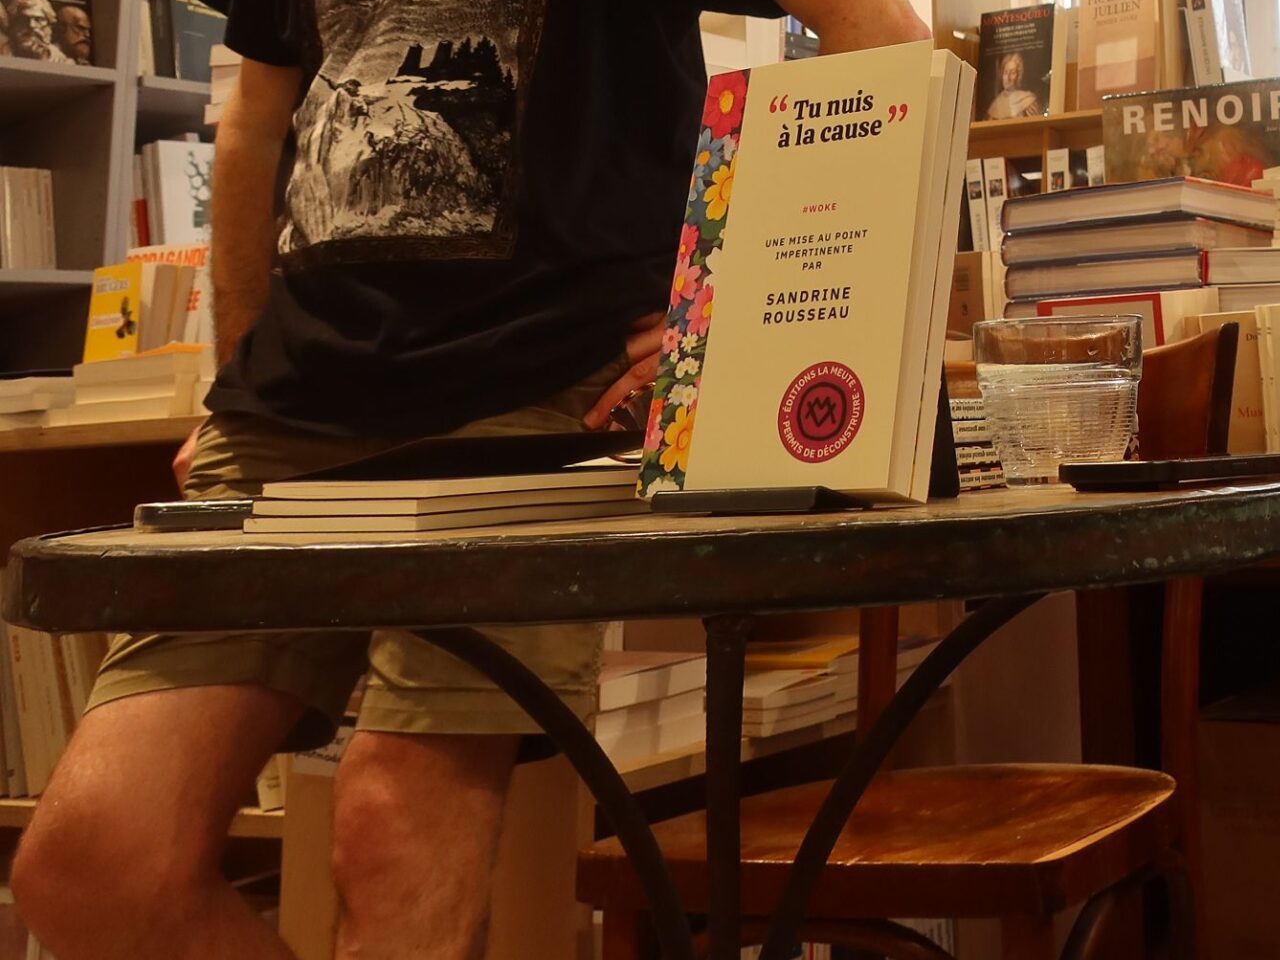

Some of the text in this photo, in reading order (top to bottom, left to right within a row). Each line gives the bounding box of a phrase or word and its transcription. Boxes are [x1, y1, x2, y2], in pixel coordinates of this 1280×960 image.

[983, 7, 1050, 25] MONTESQUIEU
[1093, 0, 1141, 19] JULLIEN
[793, 99, 820, 120] Tu
[825, 90, 874, 117] nuis
[777, 125, 789, 148] à
[795, 124, 815, 145] la
[820, 118, 882, 143] cause
[802, 202, 837, 214] #WOKE
[765, 229, 868, 248] UNE MISE AU POINT
[775, 244, 854, 260] IMPERTINENTE
[802, 261, 822, 271] PAR
[766, 286, 852, 306] SANDRINE
[762, 306, 850, 325] ROUSSEAU
[783, 366, 856, 412] ÉDITIONS LA MEUTE
[783, 392, 860, 457] PERMIS DE DÉCONSTRUIRE
